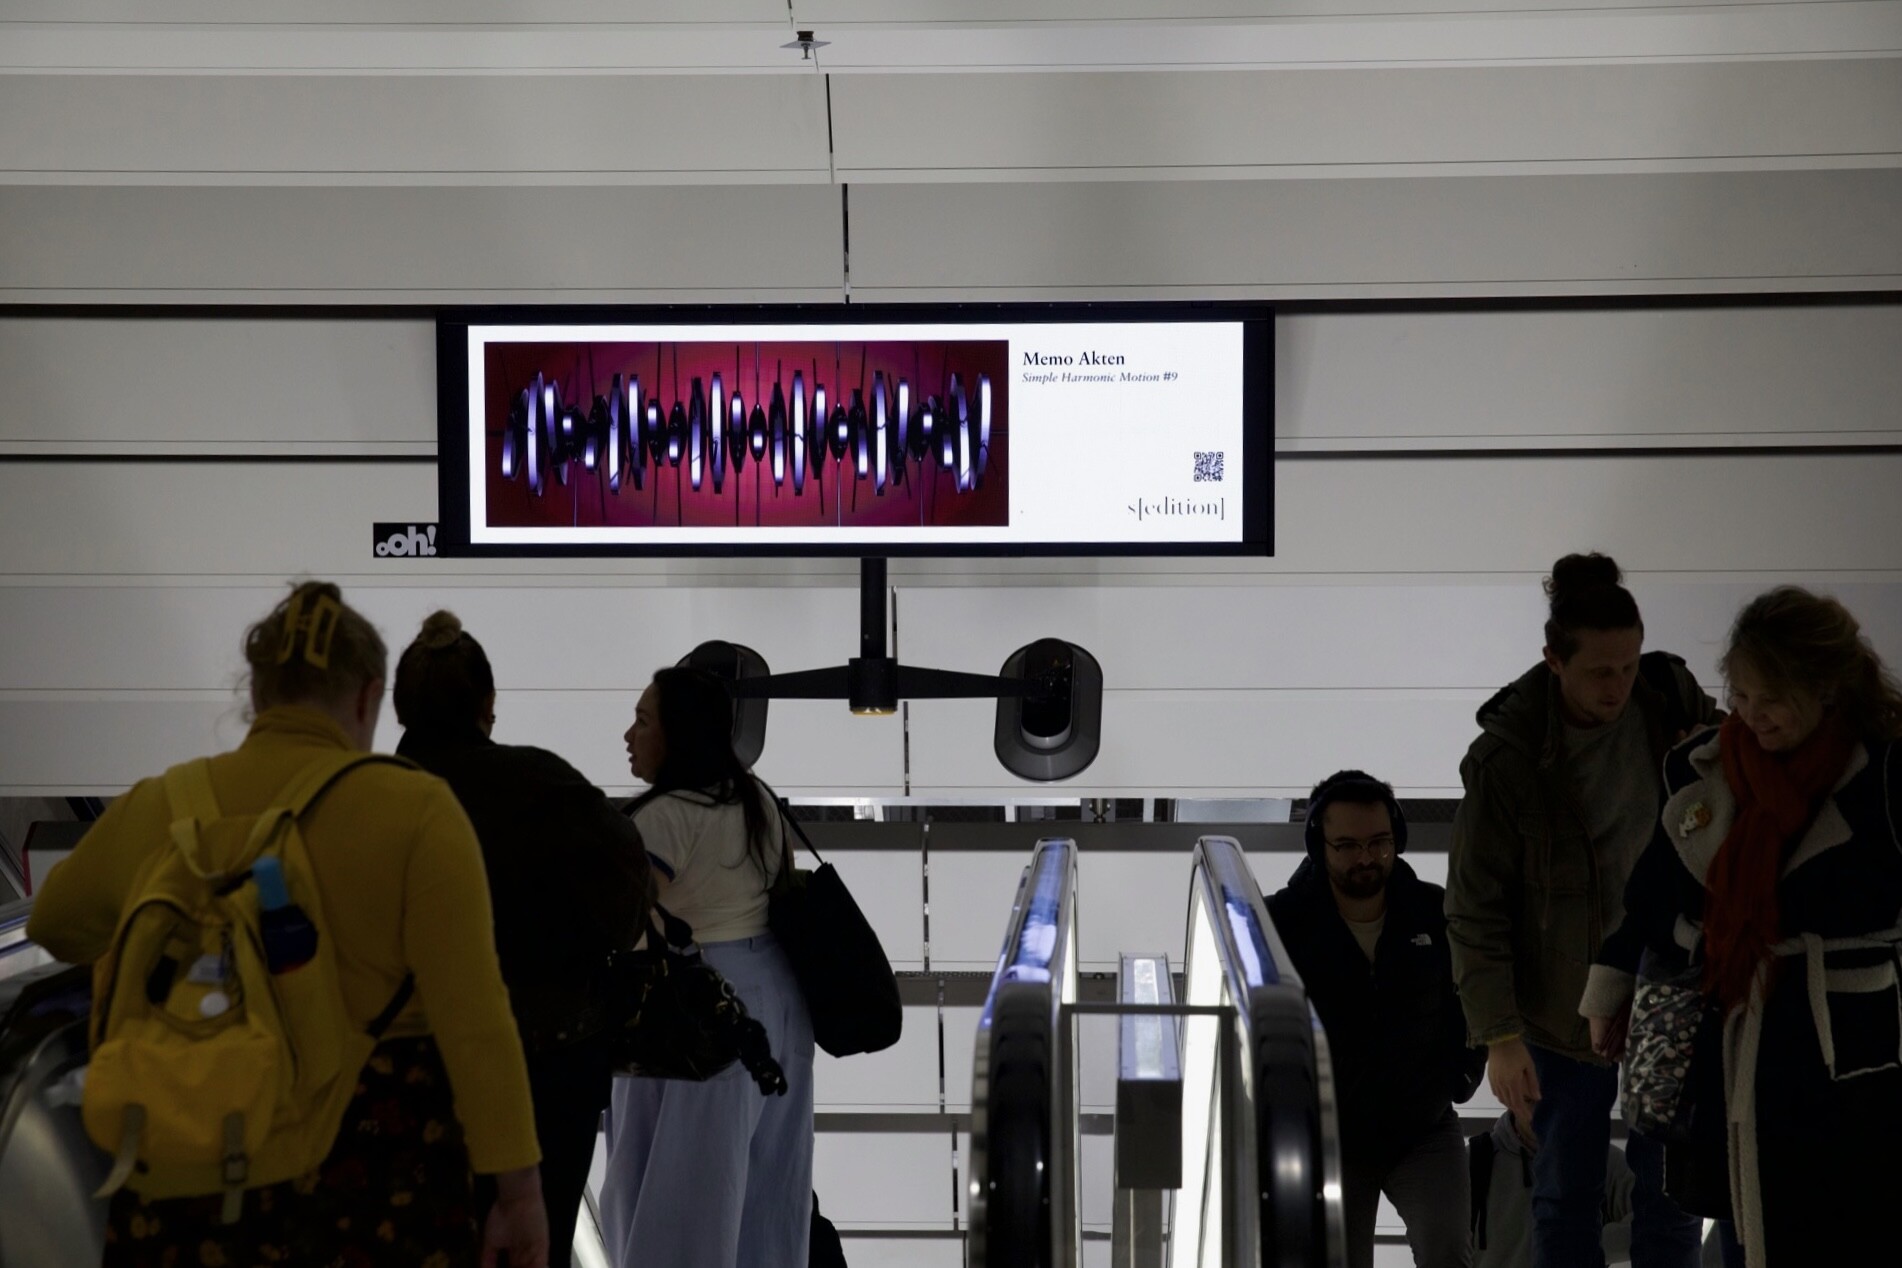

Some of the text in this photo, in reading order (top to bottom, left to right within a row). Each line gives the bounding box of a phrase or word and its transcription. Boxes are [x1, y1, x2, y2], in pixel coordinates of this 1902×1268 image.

[1022, 350, 1126, 366] Memo Akten
[1022, 371, 1179, 385] Simple Harmonic Motion #9
